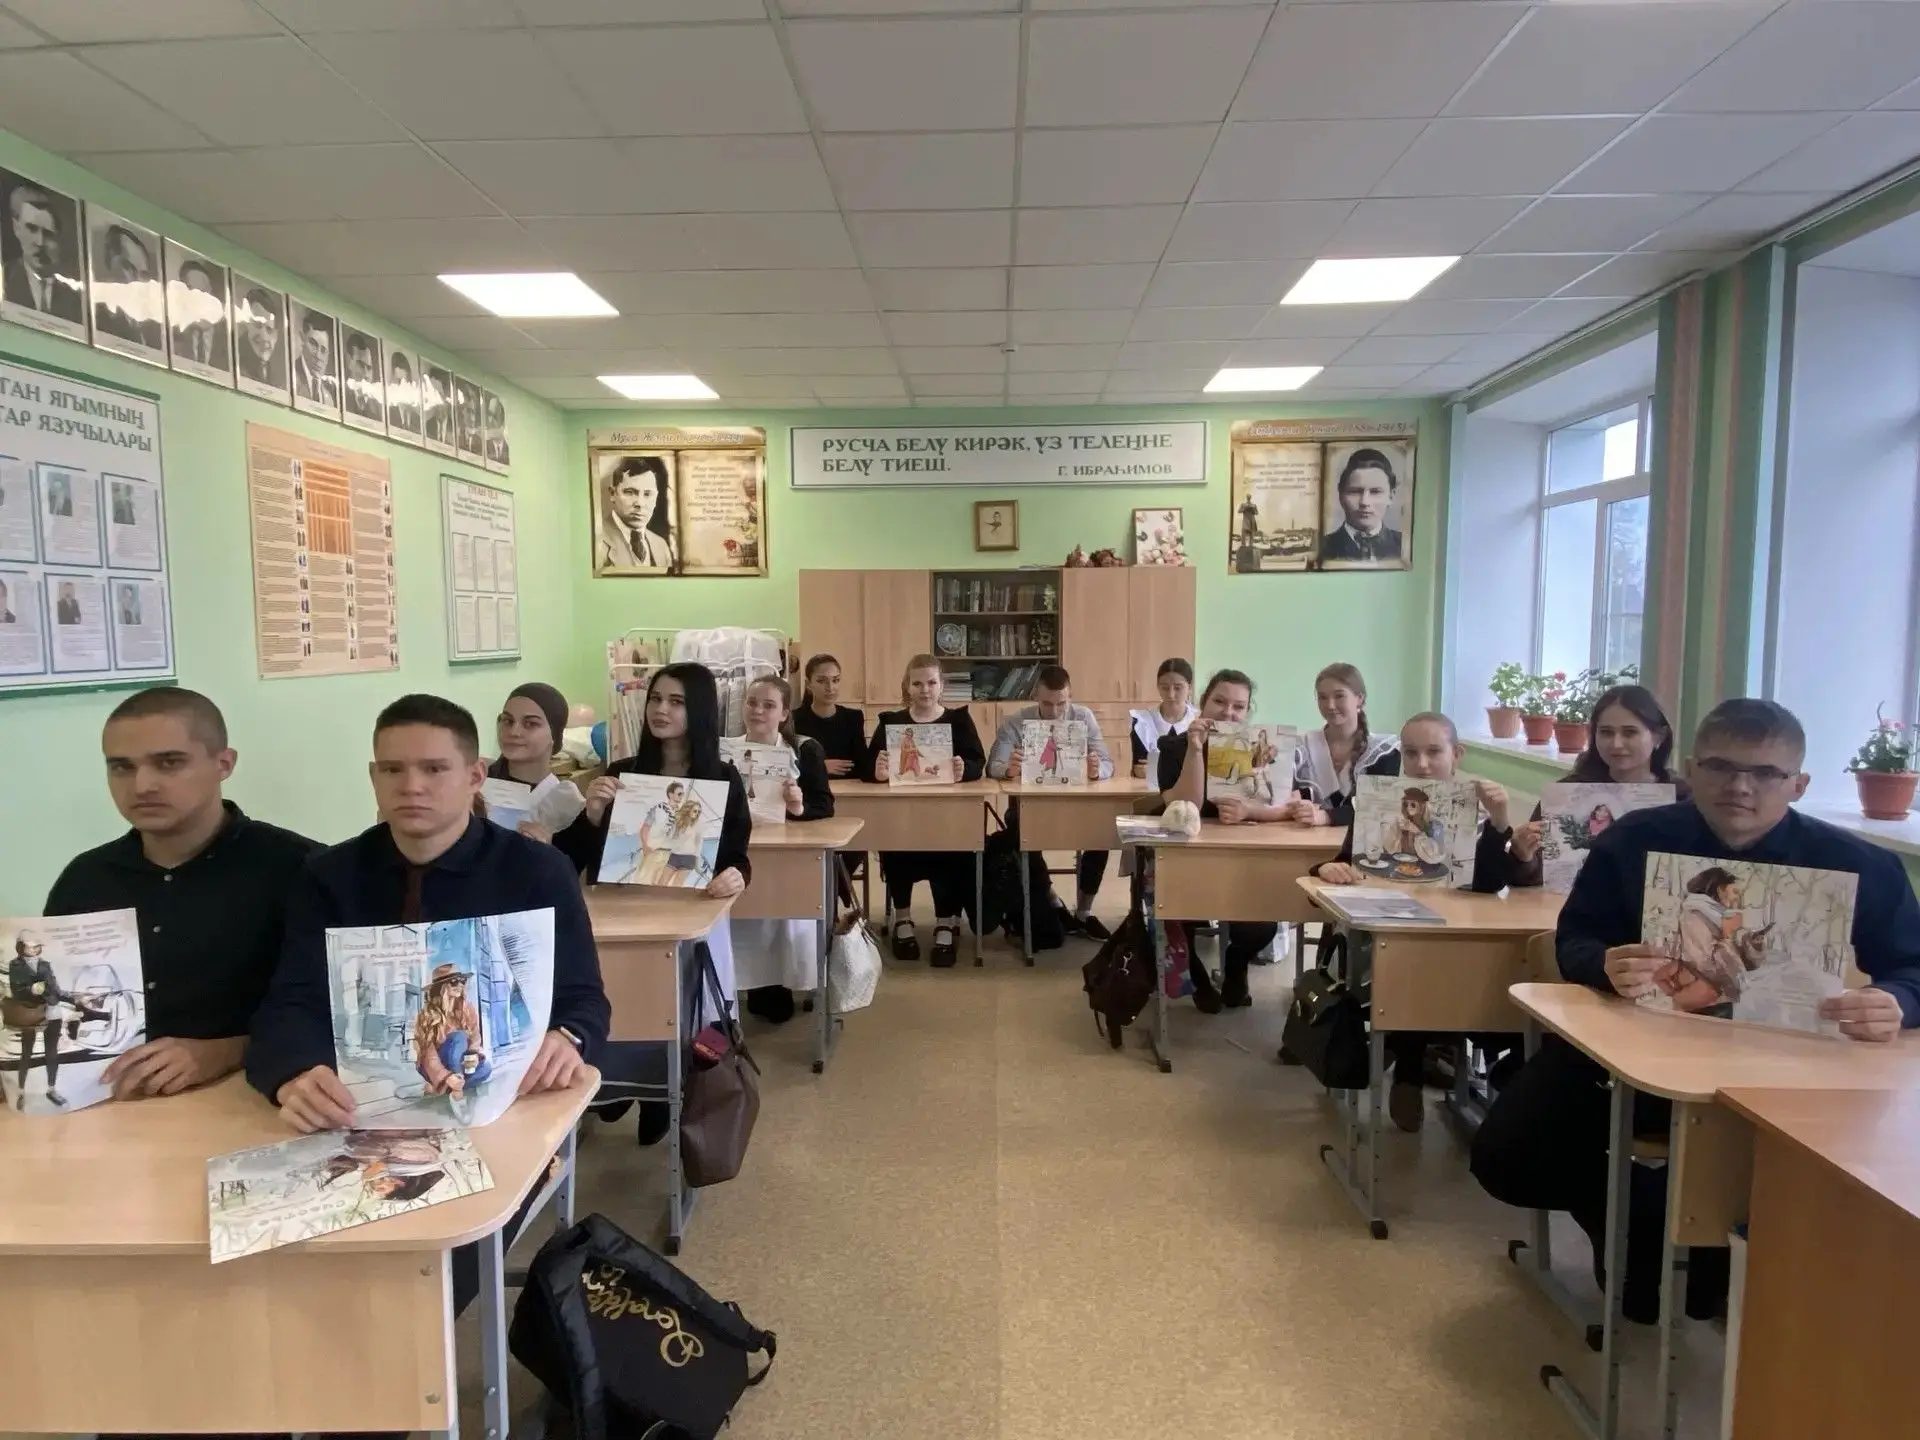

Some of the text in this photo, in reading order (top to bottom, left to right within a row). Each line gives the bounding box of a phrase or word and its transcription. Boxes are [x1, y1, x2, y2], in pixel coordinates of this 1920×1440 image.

[49, 389, 145, 430] ЯГЫМНЫҢ
[0, 405, 152, 452] АР ЯЗУЧЫЛАРЫ
[822, 438, 891, 452] РУСЧА
[1068, 434, 1173, 451] ТЕЛЕҢНЕ
[880, 457, 951, 472] ТИЕШ.
[1057, 465, 1069, 476] Г.
